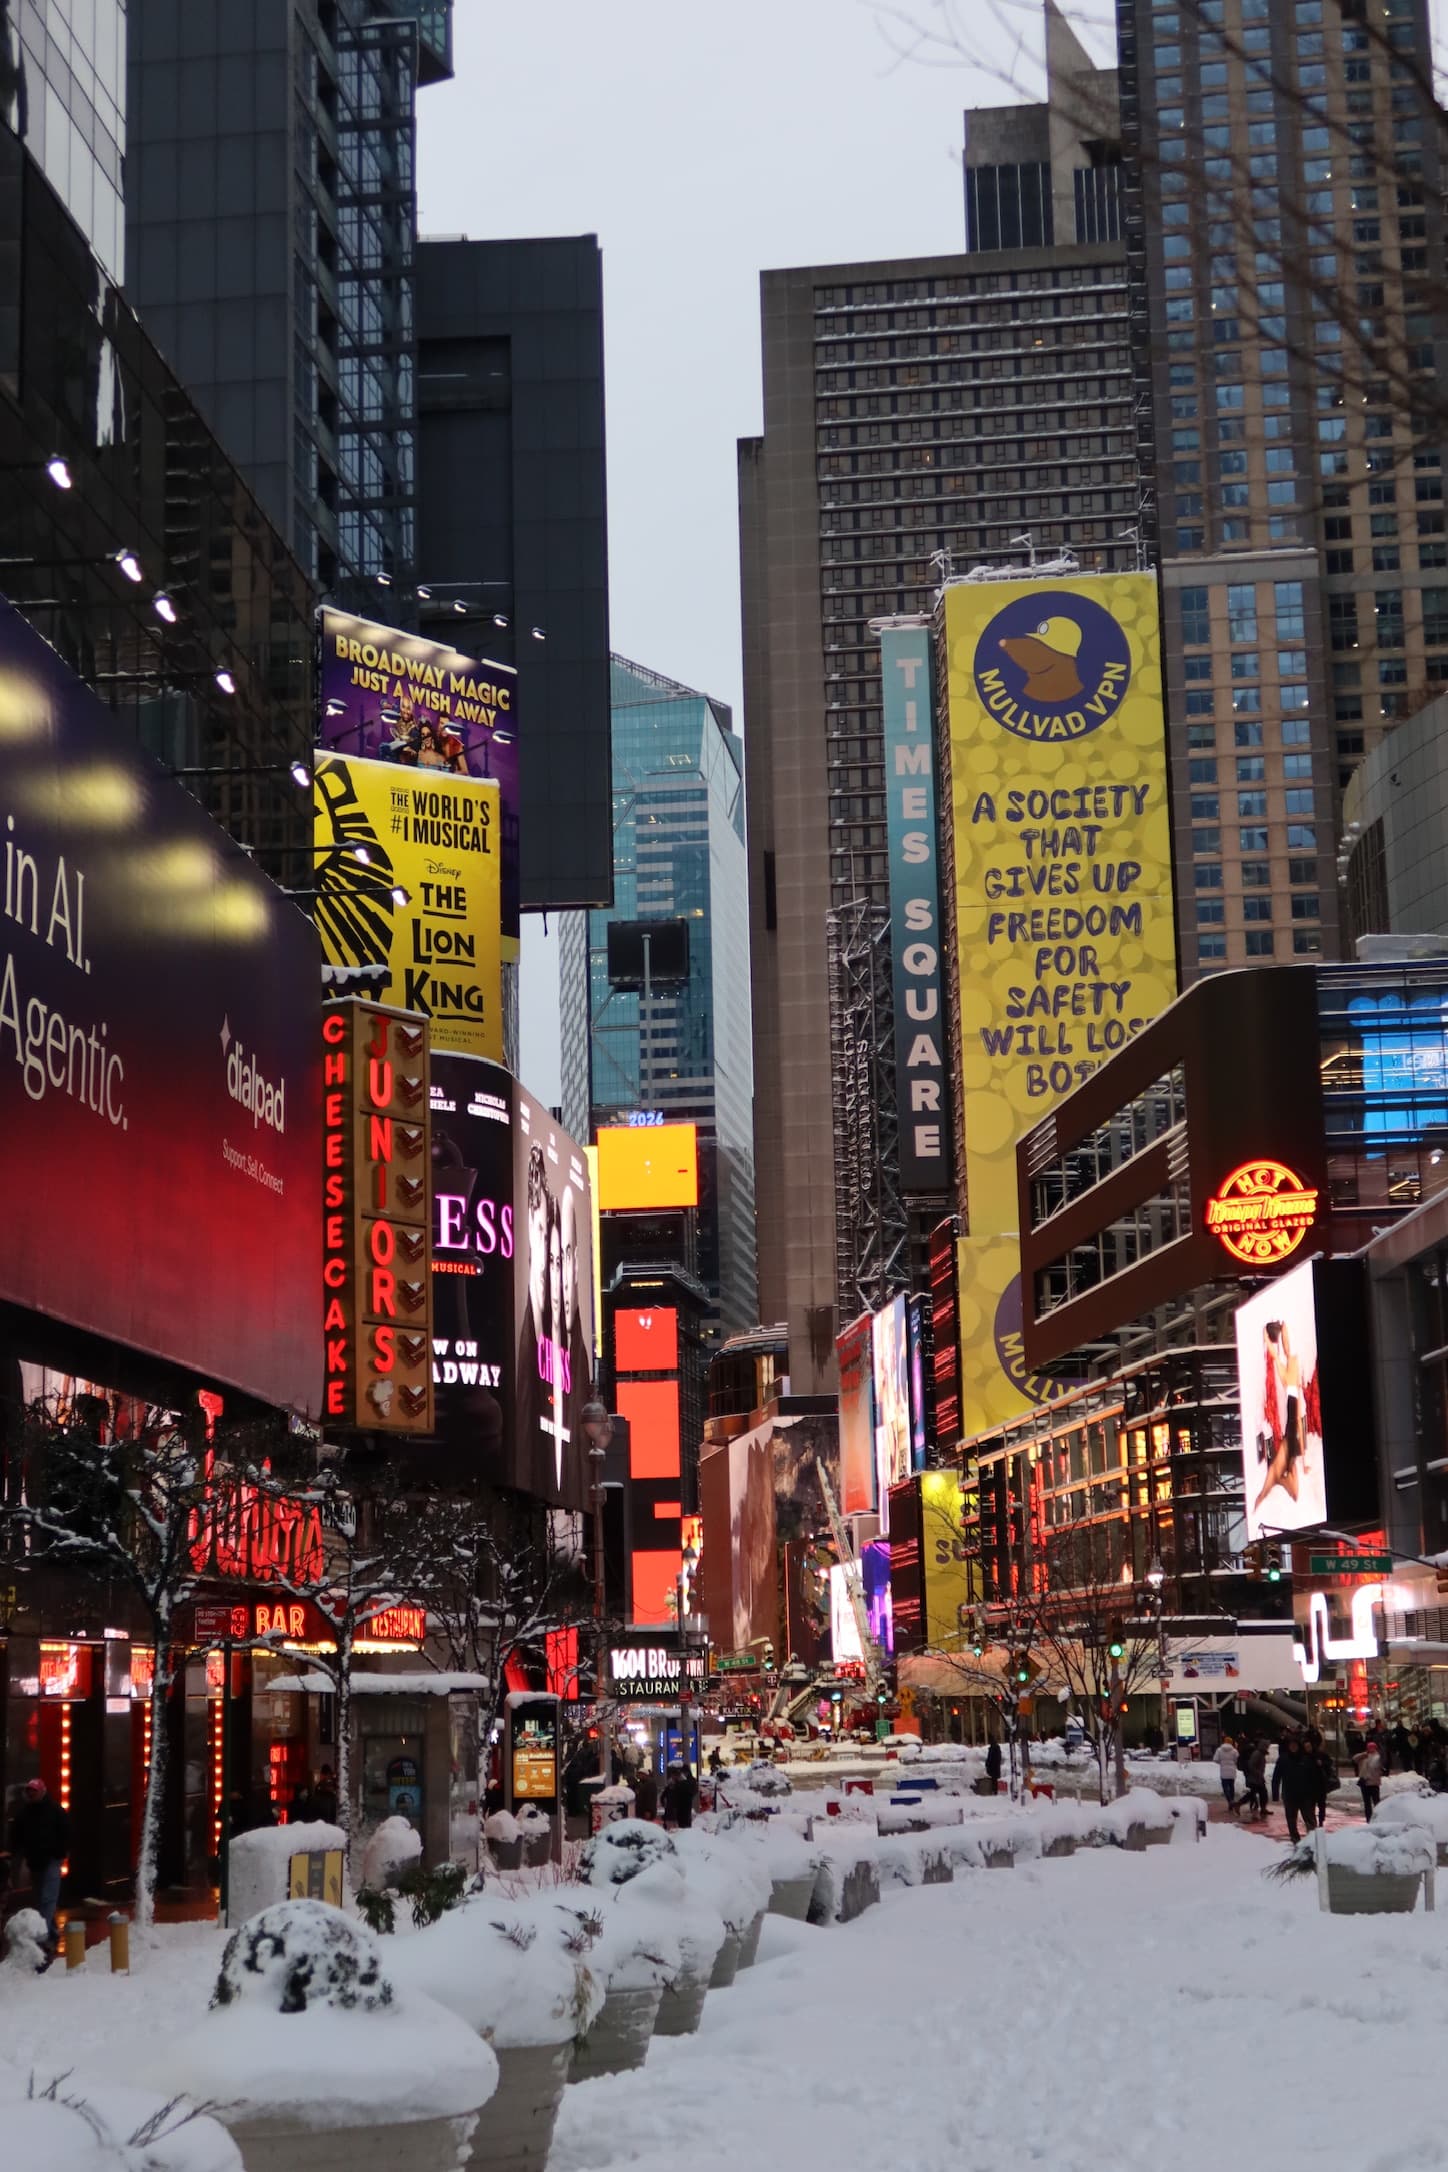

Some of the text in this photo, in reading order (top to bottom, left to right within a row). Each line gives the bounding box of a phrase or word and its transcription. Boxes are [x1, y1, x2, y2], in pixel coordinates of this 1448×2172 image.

[335, 633, 511, 711] BROADWAY MAGIC
[350, 666, 497, 728] JUST A WISH AWAY
[978, 661, 1127, 738] MULLVAD VPN
[391, 790, 490, 826] THE WORLD'S
[972, 784, 1150, 824] A SOCIETY
[390, 815, 491, 854] #1 MUSICAL
[1019, 824, 1103, 860] THAT
[4, 815, 91, 975] in AI.
[420, 881, 467, 911] THE
[985, 860, 1142, 899] GIVES UP
[894, 658, 942, 1158] TIMES SQUARE
[988, 902, 1142, 945] FREEDOM
[411, 918, 475, 965] LION
[1035, 945, 1100, 981] FOR
[404, 968, 484, 1018] KING
[1006, 980, 1131, 1018] SAFETY
[0, 953, 128, 1131] Agentic.
[980, 1017, 1155, 1057] WILL LOS
[227, 1040, 285, 1134] dialpad
[430, 1086, 445, 1098] EA
[1026, 1059, 1101, 1097] BOT
[430, 1099, 457, 1112] HELE
[628, 1111, 665, 1127] 2026
[258, 1163, 284, 1195] Connect
[368, 1016, 396, 1373] JUNIORS
[1237, 1169, 1286, 1192] HOT
[322, 1014, 347, 1415] CHEESECAKE
[434, 1193, 514, 1259] ESS
[1207, 1190, 1319, 1225] Krispy Kreme
[1213, 1216, 1315, 1234] ORIGINAL GLAZED
[1238, 1229, 1292, 1257] NOW
[431, 1260, 477, 1276] MUSICAL
[454, 1340, 478, 1357] ON
[537, 1333, 571, 1395] CHSS
[432, 1361, 501, 1388] ADWAY
[1325, 1559, 1378, 1570] W 49 St
[256, 1605, 305, 1638] BAR
[371, 1606, 425, 1640] RESTAURANT
[611, 1649, 647, 1680] 1604
[617, 1680, 681, 1698] STAURAN
